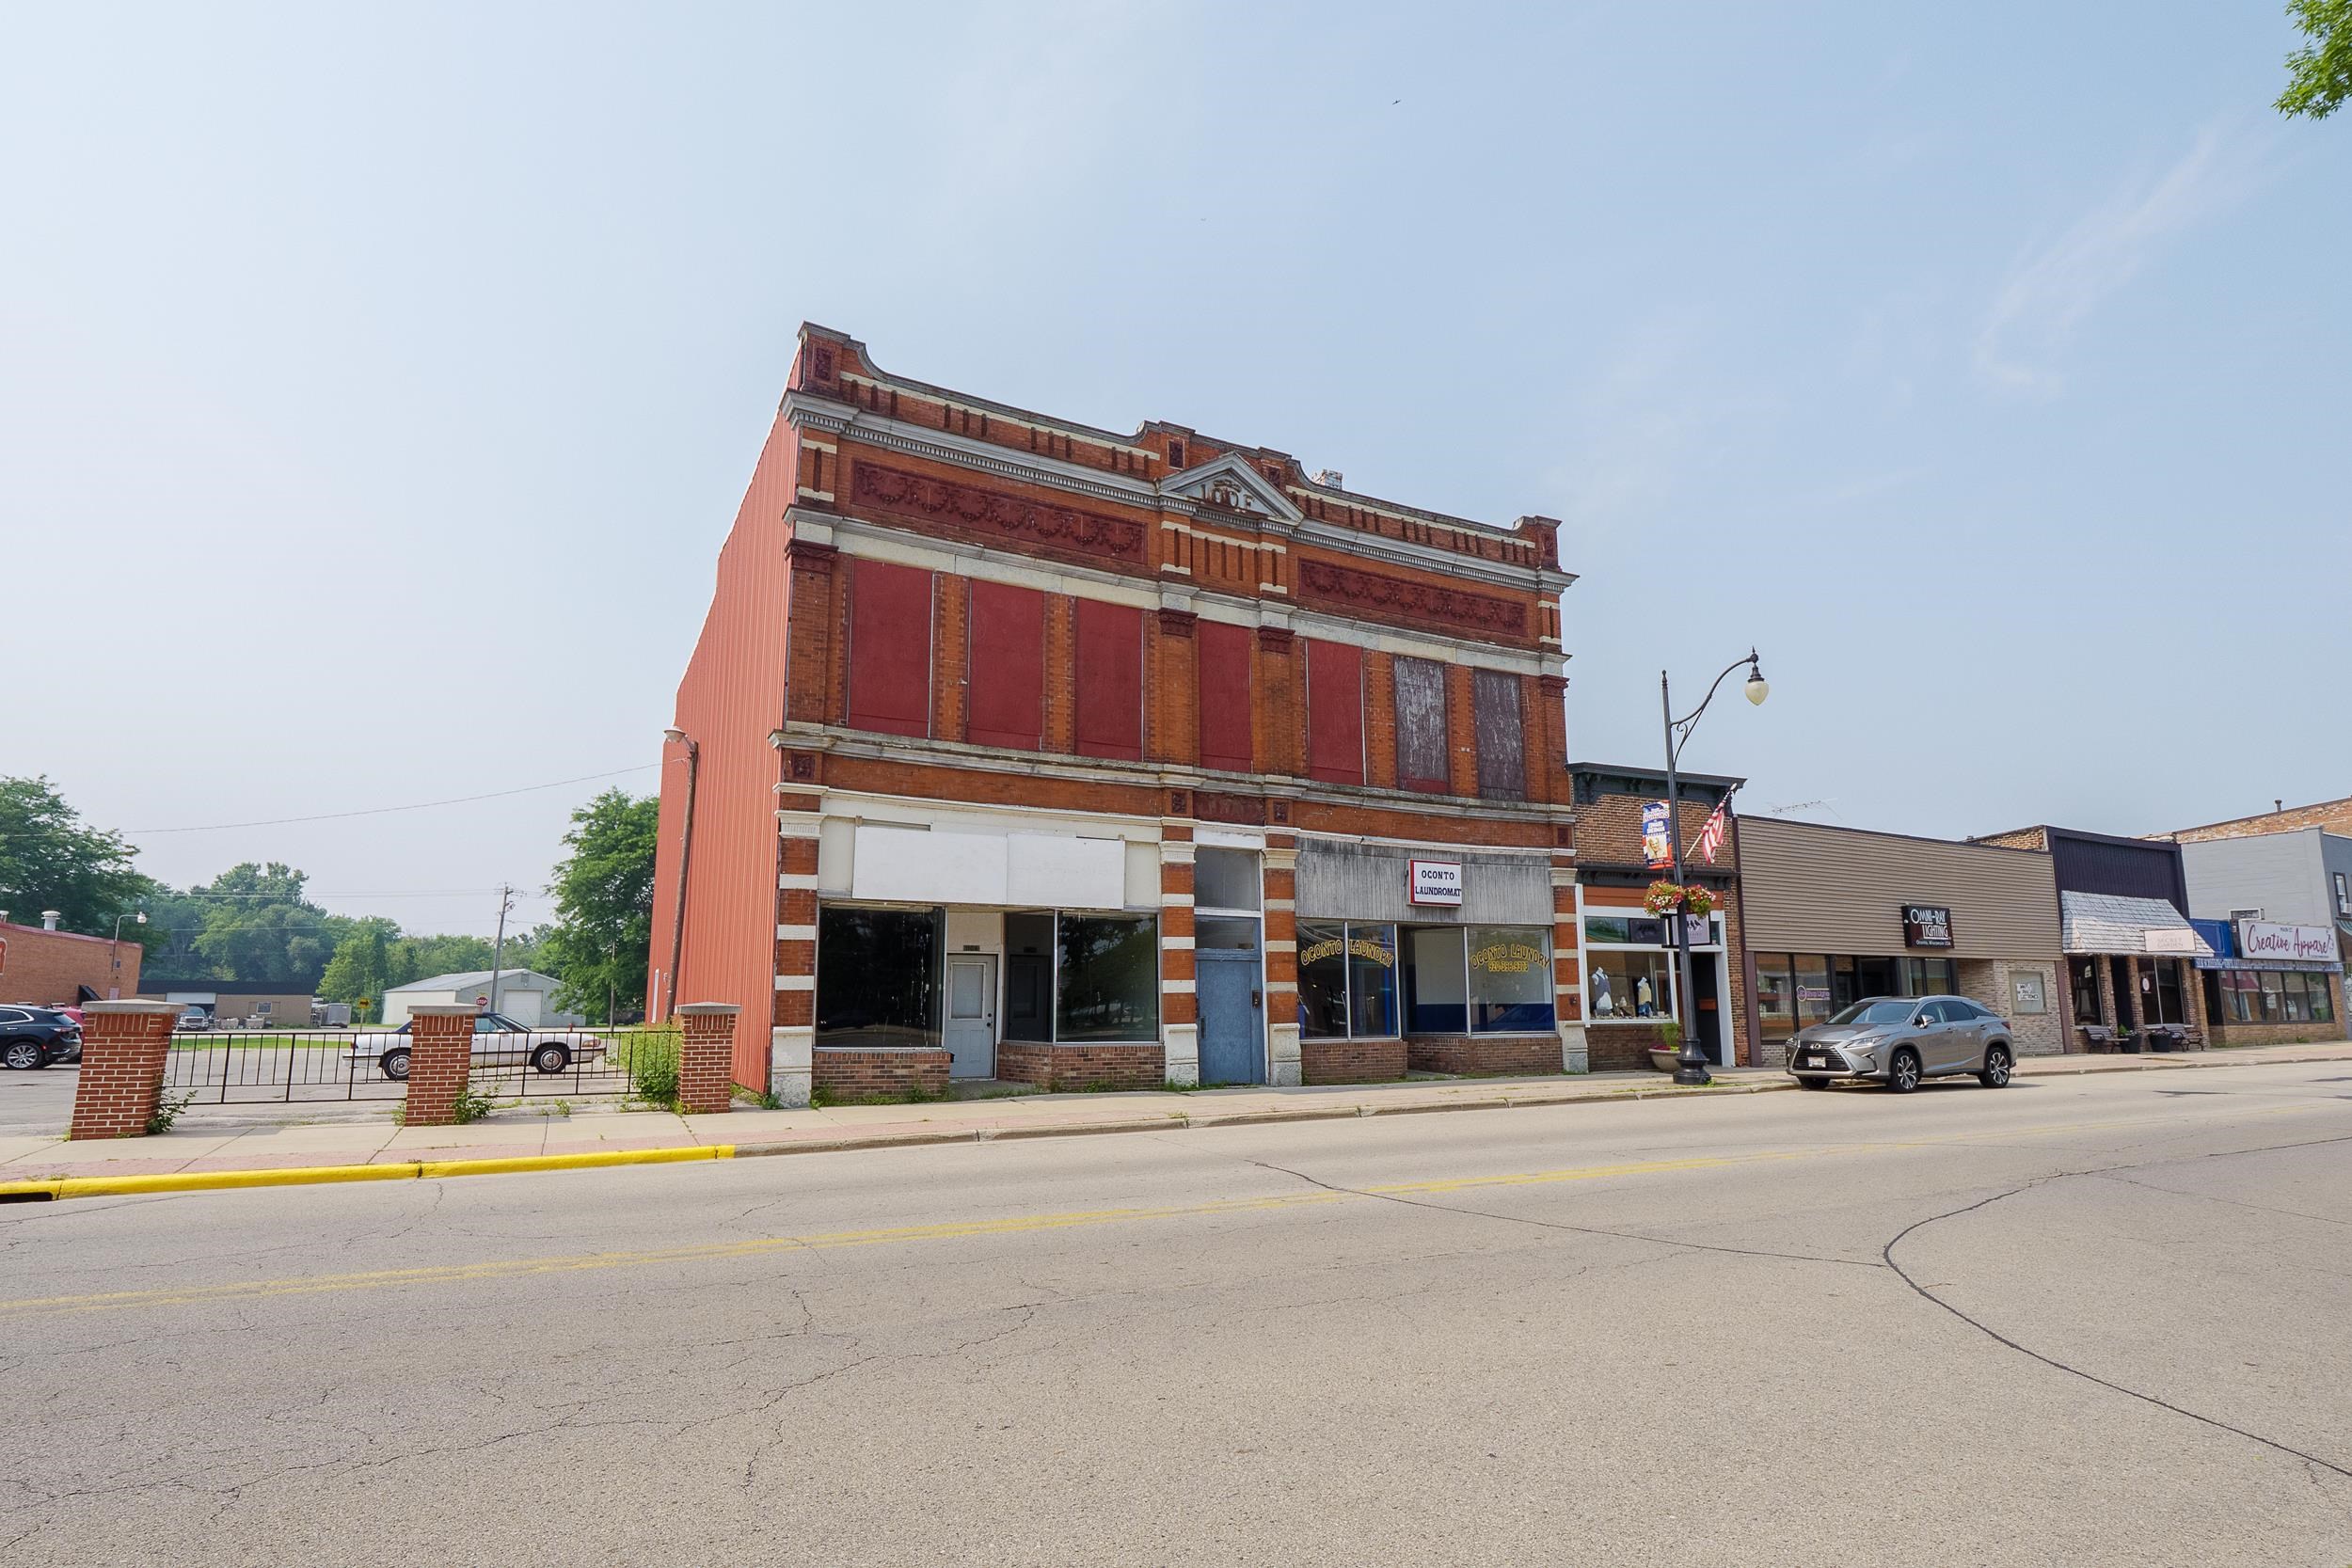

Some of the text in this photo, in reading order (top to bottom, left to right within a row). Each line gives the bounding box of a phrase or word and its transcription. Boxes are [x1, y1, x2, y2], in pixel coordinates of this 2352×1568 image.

[1421, 870, 1454, 880] OCONTO
[1415, 885, 1461, 896] LAUNDROMAT
[2248, 924, 2290, 953] Creative
[1300, 939, 1395, 968] OCONTO LAUNDRY
[1470, 943, 1550, 970] OCONTO LAUNDRY
